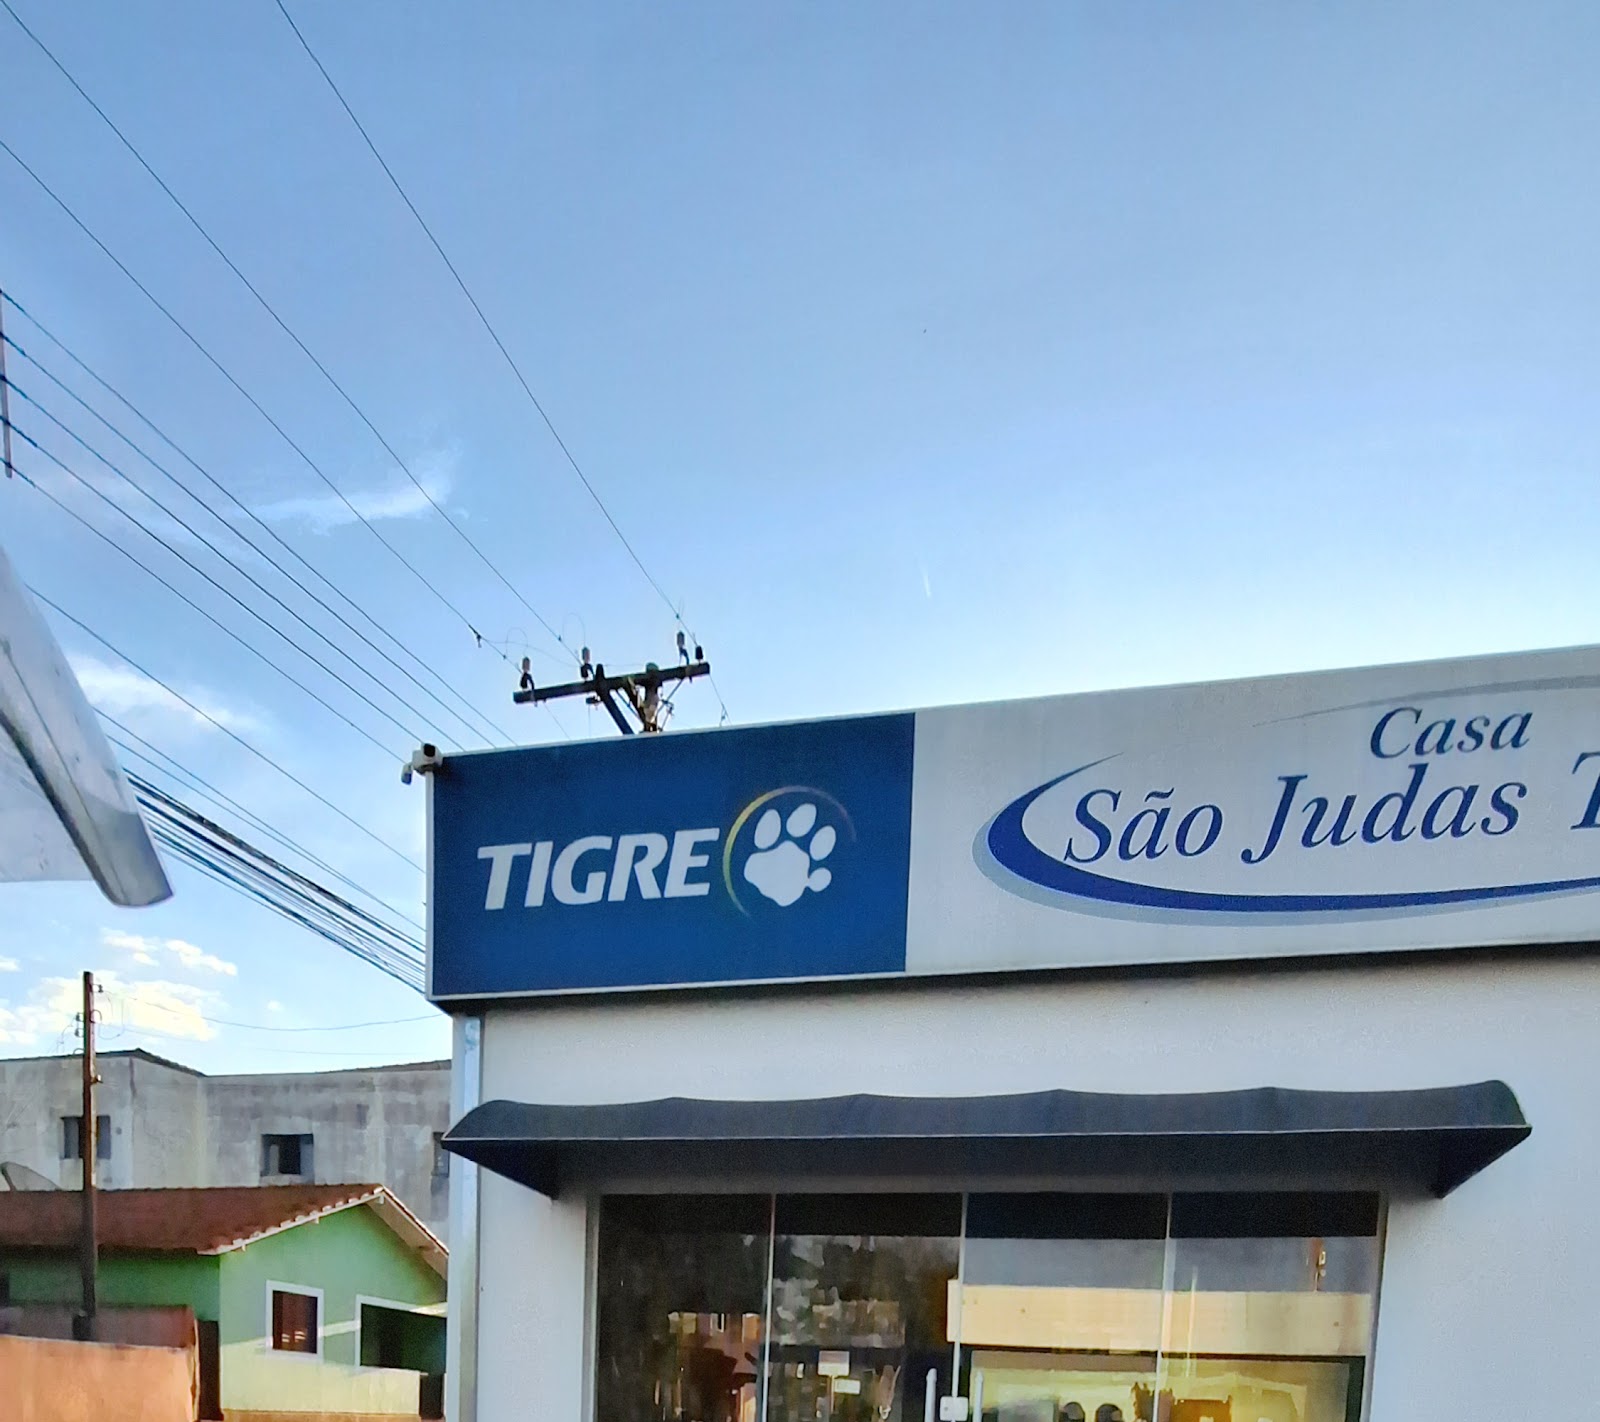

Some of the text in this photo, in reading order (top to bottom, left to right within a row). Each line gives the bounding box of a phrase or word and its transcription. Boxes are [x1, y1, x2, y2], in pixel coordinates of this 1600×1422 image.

[1370, 706, 1533, 759] Casa
[1064, 787, 1223, 863] São
[1241, 763, 1527, 865] Judas
[476, 828, 719, 910] TIGRE
